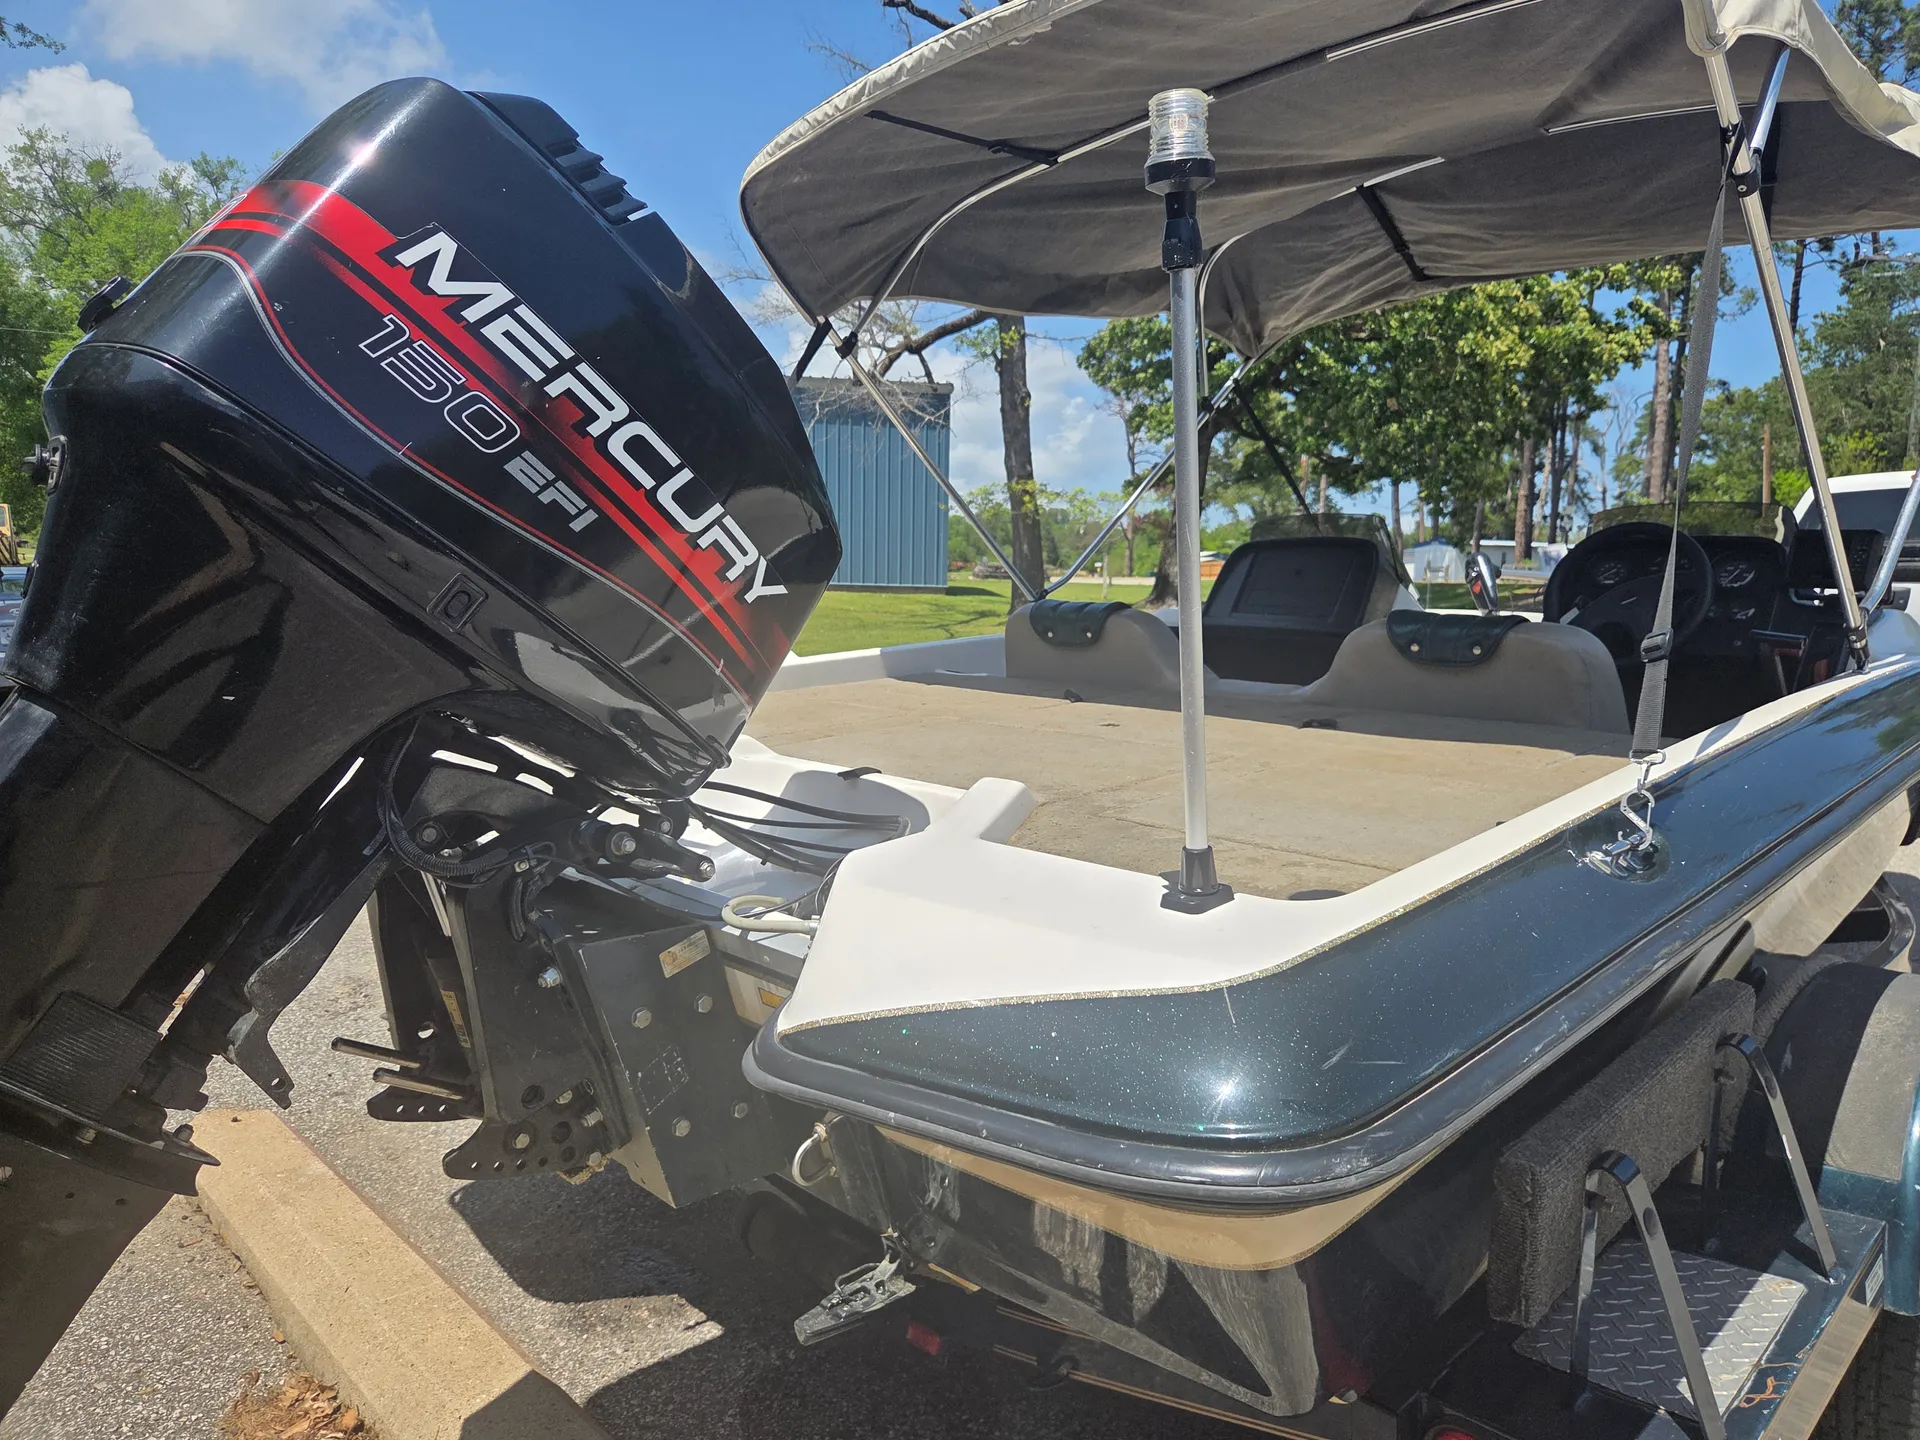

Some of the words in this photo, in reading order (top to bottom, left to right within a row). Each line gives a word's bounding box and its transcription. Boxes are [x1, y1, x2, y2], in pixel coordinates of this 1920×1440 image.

[358, 314, 521, 453] 150
[503, 450, 599, 533] EFI
[394, 231, 789, 604] MERCURY
